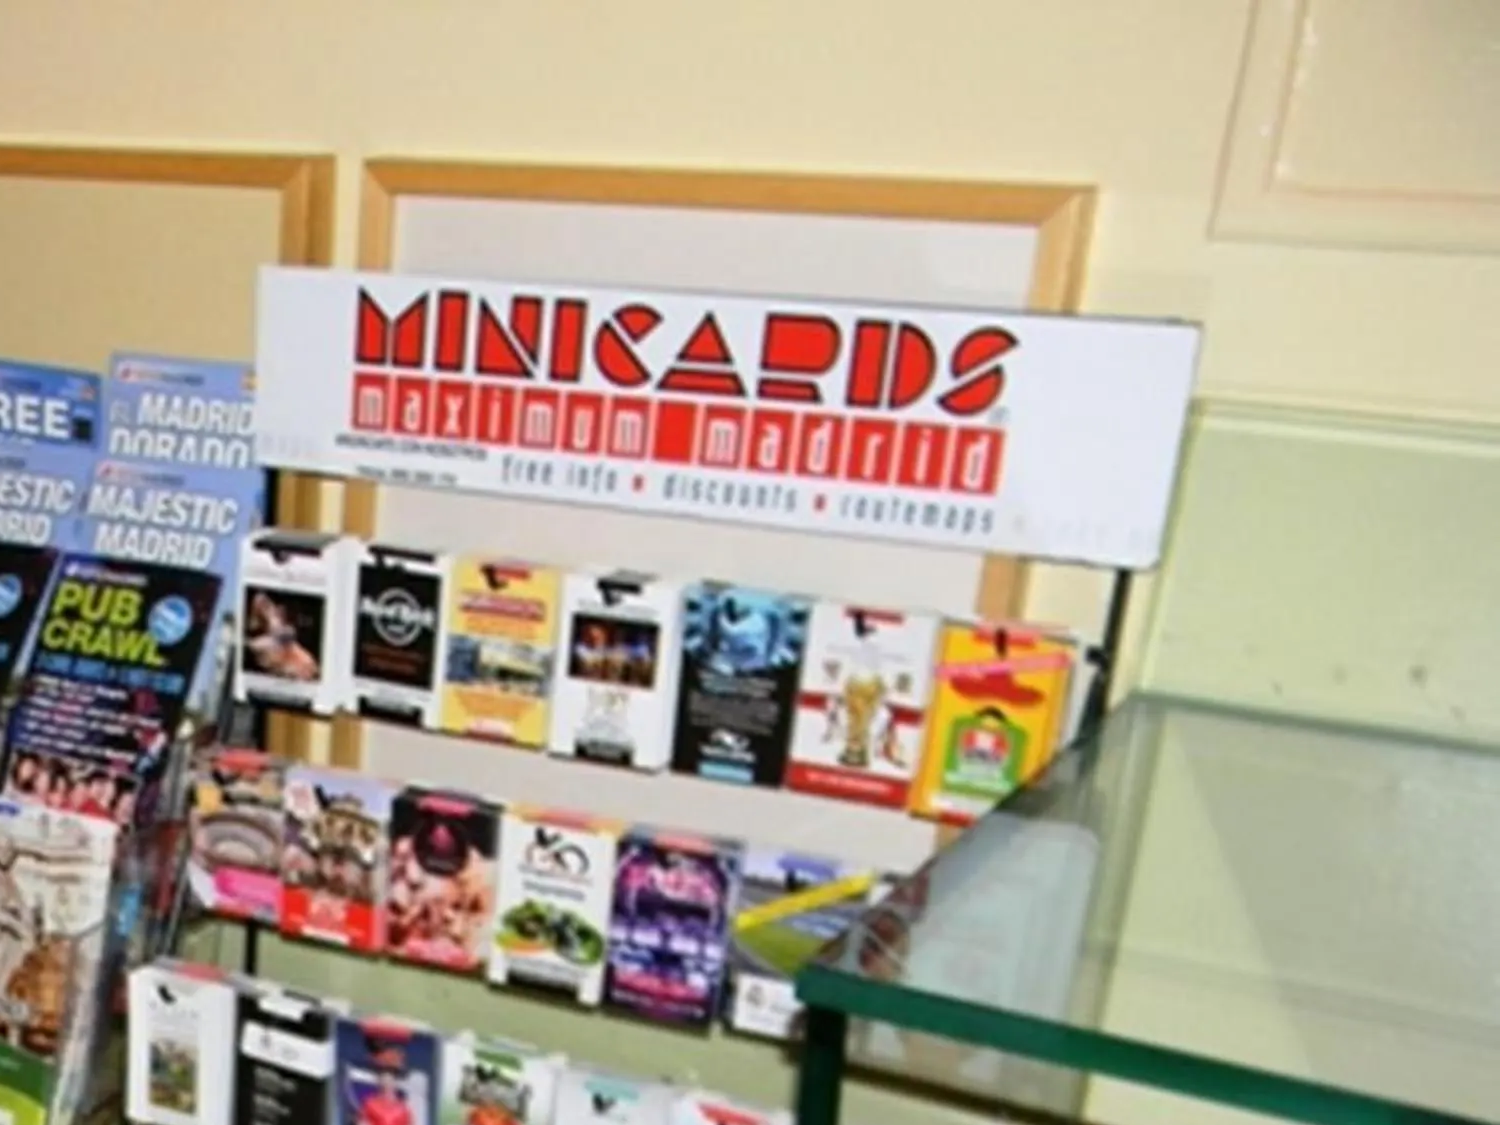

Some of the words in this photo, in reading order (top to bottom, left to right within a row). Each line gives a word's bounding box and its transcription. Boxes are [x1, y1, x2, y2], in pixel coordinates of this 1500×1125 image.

[355, 286, 1020, 418] MINICARDS
[357, 385, 644, 458] maximum
[705, 418, 992, 491] madrid
[87, 484, 239, 534] MAJESTIC
[501, 453, 551, 485] free
[565, 461, 618, 494] info
[662, 472, 798, 512] discounts
[840, 496, 995, 535] routemaps
[94, 524, 214, 570] MADRID
[53, 581, 143, 626] PUB
[43, 618, 168, 667] CRAWL
